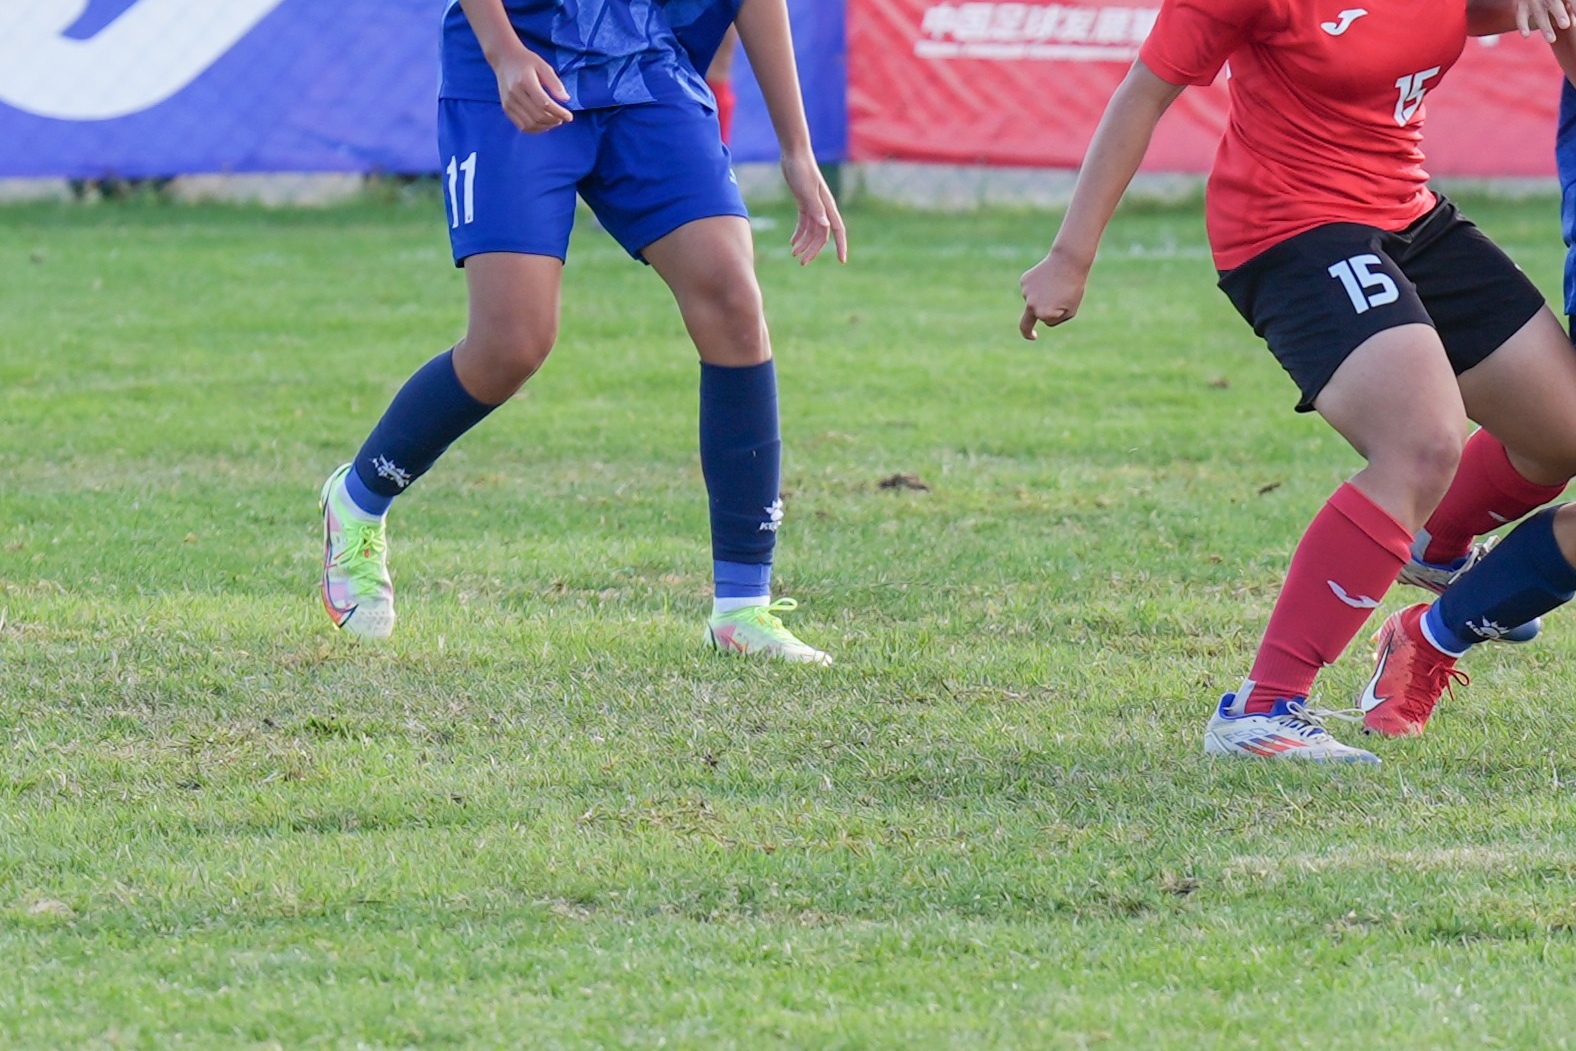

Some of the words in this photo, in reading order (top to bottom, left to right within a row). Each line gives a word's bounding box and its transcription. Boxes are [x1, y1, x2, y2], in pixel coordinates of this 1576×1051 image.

[1393, 65, 1441, 128] 15
[446, 152, 477, 229] 11
[1327, 254, 1399, 315] 15
